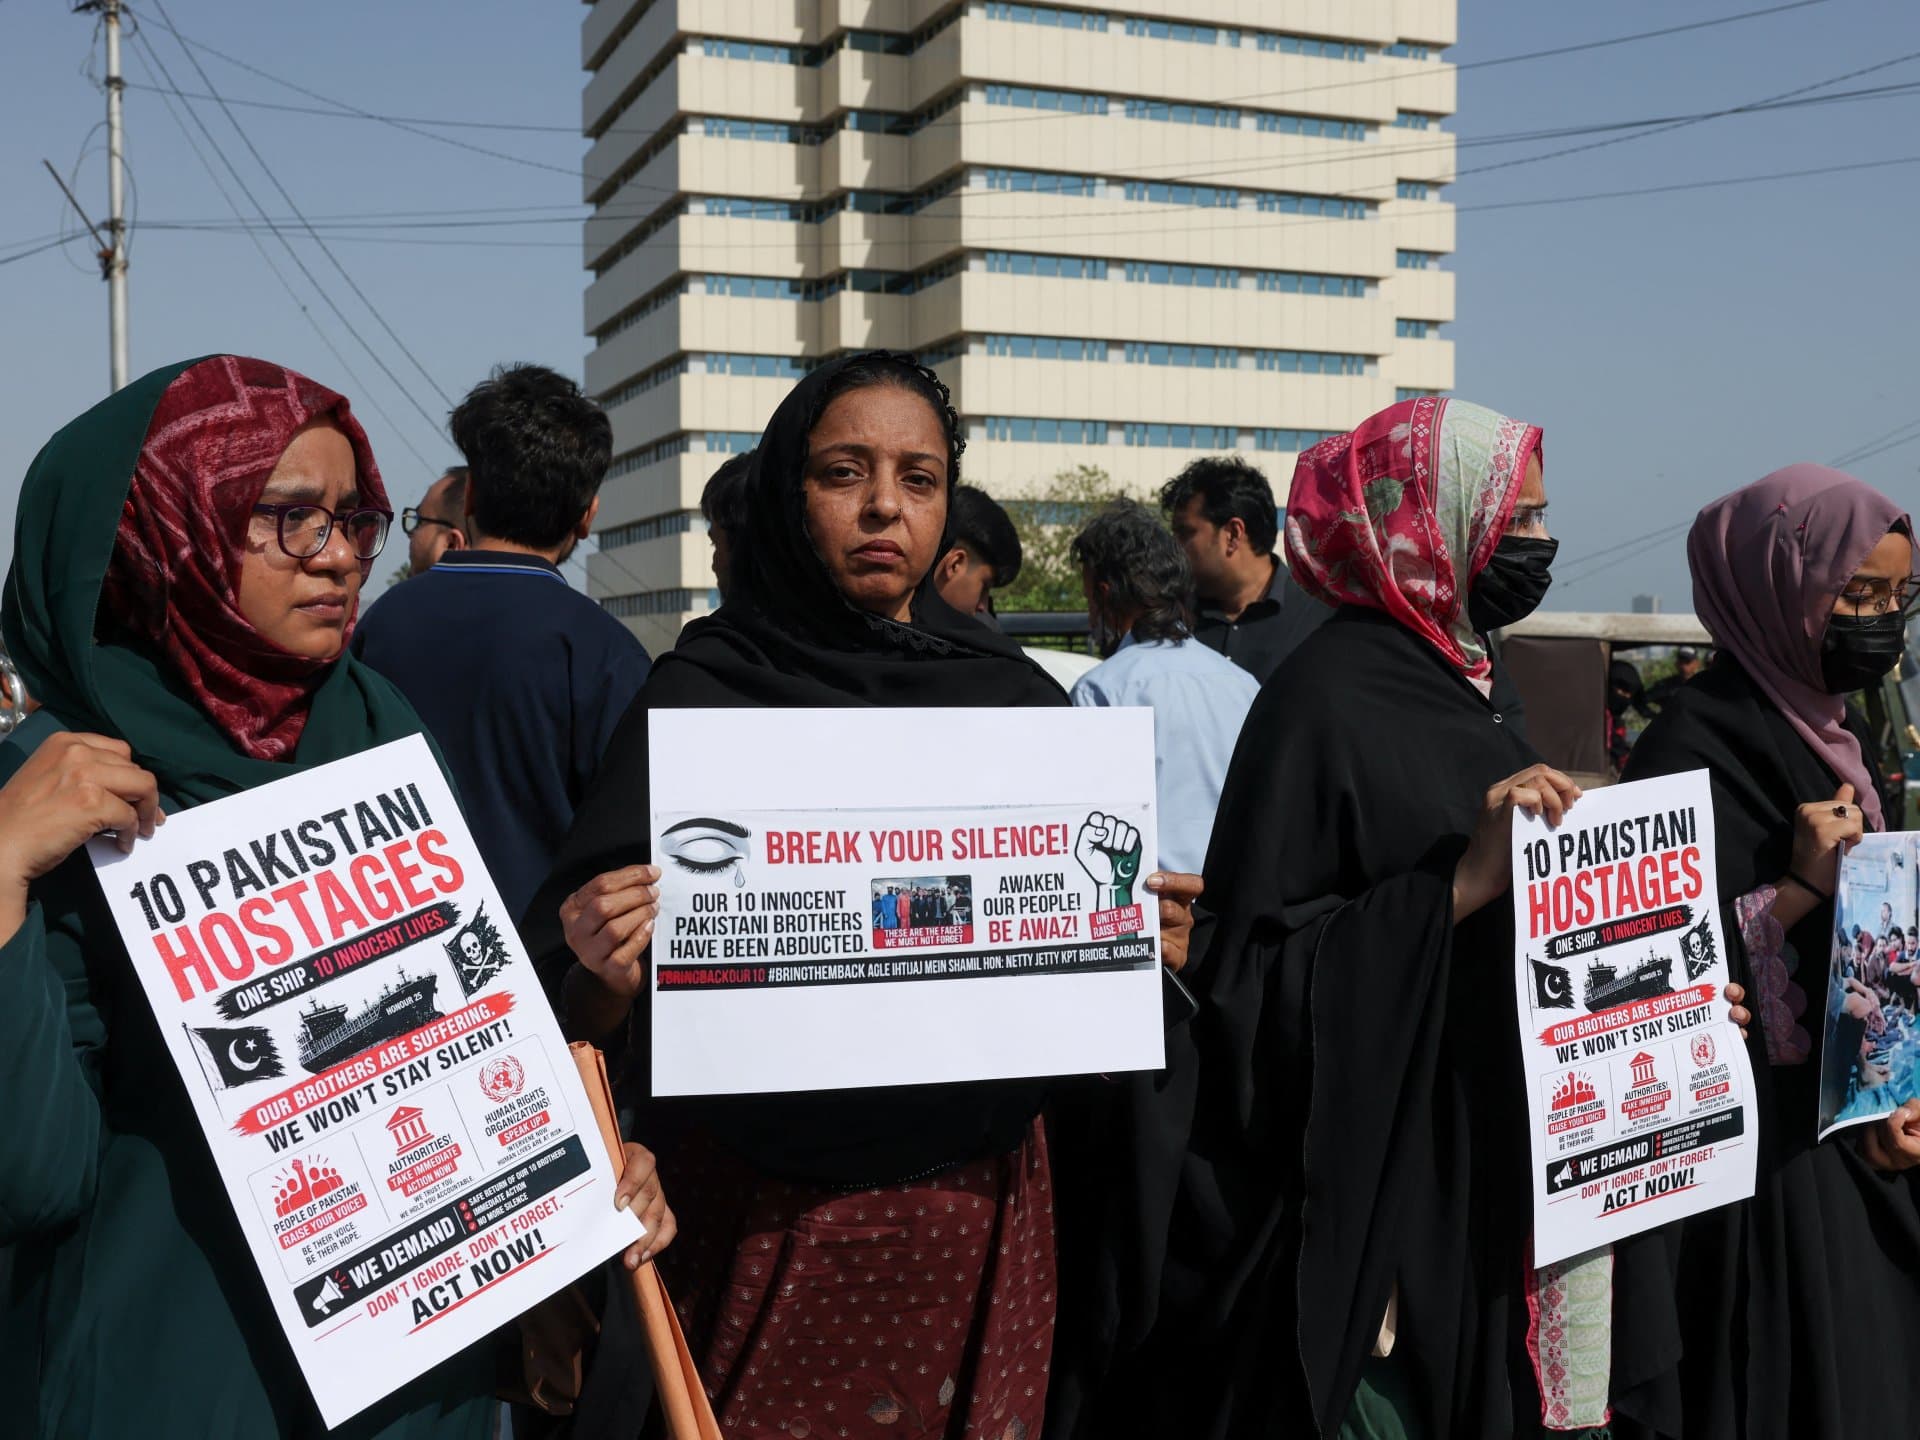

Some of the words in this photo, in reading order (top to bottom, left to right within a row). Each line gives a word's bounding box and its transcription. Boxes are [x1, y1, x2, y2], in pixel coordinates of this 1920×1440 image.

[129, 873, 185, 930] 10
[186, 782, 433, 910] PAKISTANI
[766, 831, 862, 864] BREAK
[869, 829, 943, 862] YOUR
[951, 823, 1068, 859] SILENCE!
[1523, 838, 1550, 880] 10
[1558, 806, 1696, 873] PAKISTANI
[692, 893, 727, 912] OUR
[735, 892, 755, 911] 10
[761, 890, 845, 911] INNOCENT
[998, 872, 1064, 893] AWAKEN
[1527, 846, 1702, 938] HOSTAGES
[151, 829, 464, 1002] HOSTAGES
[675, 915, 767, 935] PAKISTANI
[773, 911, 862, 933] BROTHERS
[983, 897, 1014, 916] OUR
[1019, 892, 1080, 914] PEOPLE!
[1095, 910, 1119, 925] UNITE
[1120, 906, 1136, 919] AND
[670, 939, 717, 958] HAVE
[723, 937, 768, 957] BEEN
[774, 934, 867, 955] ABDUCTED.
[884, 928, 907, 937] THESE
[909, 927, 923, 936] ARE
[926, 926, 938, 935] THE
[940, 925, 963, 934] FACES
[884, 938, 896, 946] WE
[898, 936, 917, 945] MUST
[920, 936, 933, 944] NOT
[936, 934, 962, 944] FORGET
[988, 919, 1013, 942] BE
[1018, 915, 1077, 940] AWAZ!
[1093, 923, 1117, 938] RAISE
[1117, 918, 1143, 932] VOICE!
[1555, 936, 1573, 954] ONE
[1575, 930, 1599, 949] SHIP.
[1601, 926, 1612, 942] 10
[1614, 915, 1656, 939] INNOCENT
[1658, 909, 1685, 928] LIVES.
[235, 982, 271, 1011] ONE
[269, 966, 313, 996] SHIP.
[312, 955, 335, 978] 10
[333, 925, 403, 969] INNOCENT
[403, 909, 448, 939] LIVES.
[753, 968, 764, 982] 10
[768, 963, 865, 981] #BRINGTHEMBACK
[867, 964, 890, 977] AGLE
[924, 959, 946, 973] MEIN
[948, 957, 981, 972] SHAMIL
[983, 955, 1003, 969] HON:
[1005, 953, 1033, 968] NETTY
[1034, 951, 1059, 965] JETTY
[1061, 949, 1077, 963] KPT
[1078, 947, 1111, 961] BRIDGE,
[385, 996, 414, 1015] HONOUR
[413, 991, 422, 1001] 25
[1553, 1024, 1575, 1041] OUR
[1577, 1008, 1629, 1035] BROTHERS
[1631, 1003, 1651, 1020] ARE
[1652, 988, 1704, 1014] SUFFERING.
[1555, 1042, 1579, 1063] WE
[1582, 1028, 1627, 1056] WON'T
[1632, 1018, 1662, 1042] STAY
[1666, 1004, 1711, 1032] SILENT!
[256, 1097, 292, 1125] OUR
[293, 1056, 376, 1108] BROTHERS
[379, 1040, 410, 1068] ARE
[411, 1003, 495, 1051] SUFFERING.
[264, 1119, 303, 1153] WE
[305, 1082, 376, 1132] WON'T
[382, 1056, 431, 1096] STAY
[436, 1018, 512, 1069] SILENT!
[1624, 1081, 1668, 1100] AUTHORITIES!
[484, 1101, 516, 1124] HUMAN
[515, 1086, 545, 1108] RIGHTS
[484, 1096, 551, 1136] ORGANIZATIONS!
[1547, 1109, 1568, 1122] PEOPLE
[1568, 1107, 1575, 1116] OF
[1577, 1099, 1605, 1114] PAKISTAN!
[1550, 1121, 1567, 1132] RAISE
[1568, 1116, 1584, 1127] YOUR
[1584, 1110, 1603, 1122] VOICE!
[503, 1121, 530, 1142] SPEAK
[529, 1114, 544, 1128] UP!
[388, 1133, 452, 1174] AUTHORITIES!
[390, 1169, 413, 1187] TAKE
[413, 1146, 458, 1176] IMMEDIATE
[1579, 1156, 1597, 1176] WE
[1600, 1141, 1648, 1170] DEMAND
[406, 1172, 434, 1193] ACTION
[433, 1161, 454, 1178] NOW!
[1581, 1179, 1608, 1199] DON'T
[1611, 1167, 1646, 1189] IGNORE.
[1649, 1158, 1676, 1176] DON'T
[1679, 1147, 1715, 1167] FORGET.
[1603, 1184, 1638, 1212] ACT
[1645, 1167, 1693, 1198] NOW!
[273, 1209, 306, 1234] PEOPLE
[305, 1203, 318, 1217] OF
[318, 1181, 359, 1210] PAKISTAN!
[282, 1224, 310, 1246] RAISE
[309, 1211, 335, 1231] YOUR
[334, 1196, 363, 1218] VOICE!
[476, 1215, 487, 1226] NO
[486, 1205, 504, 1220] MORE
[503, 1192, 528, 1210] SILENCE
[301, 1244, 312, 1255] BE
[312, 1233, 333, 1249] THEIR
[305, 1254, 316, 1265] BE
[316, 1242, 339, 1258] THEIR
[348, 1256, 382, 1288] WE
[380, 1216, 455, 1272] DEMAND
[366, 1280, 409, 1317] DON'T
[412, 1250, 468, 1291] IGNORE.
[468, 1224, 508, 1258] DON'T
[510, 1195, 563, 1234] FORGET.
[411, 1273, 463, 1324] ACT
[470, 1228, 545, 1287] NOW!
